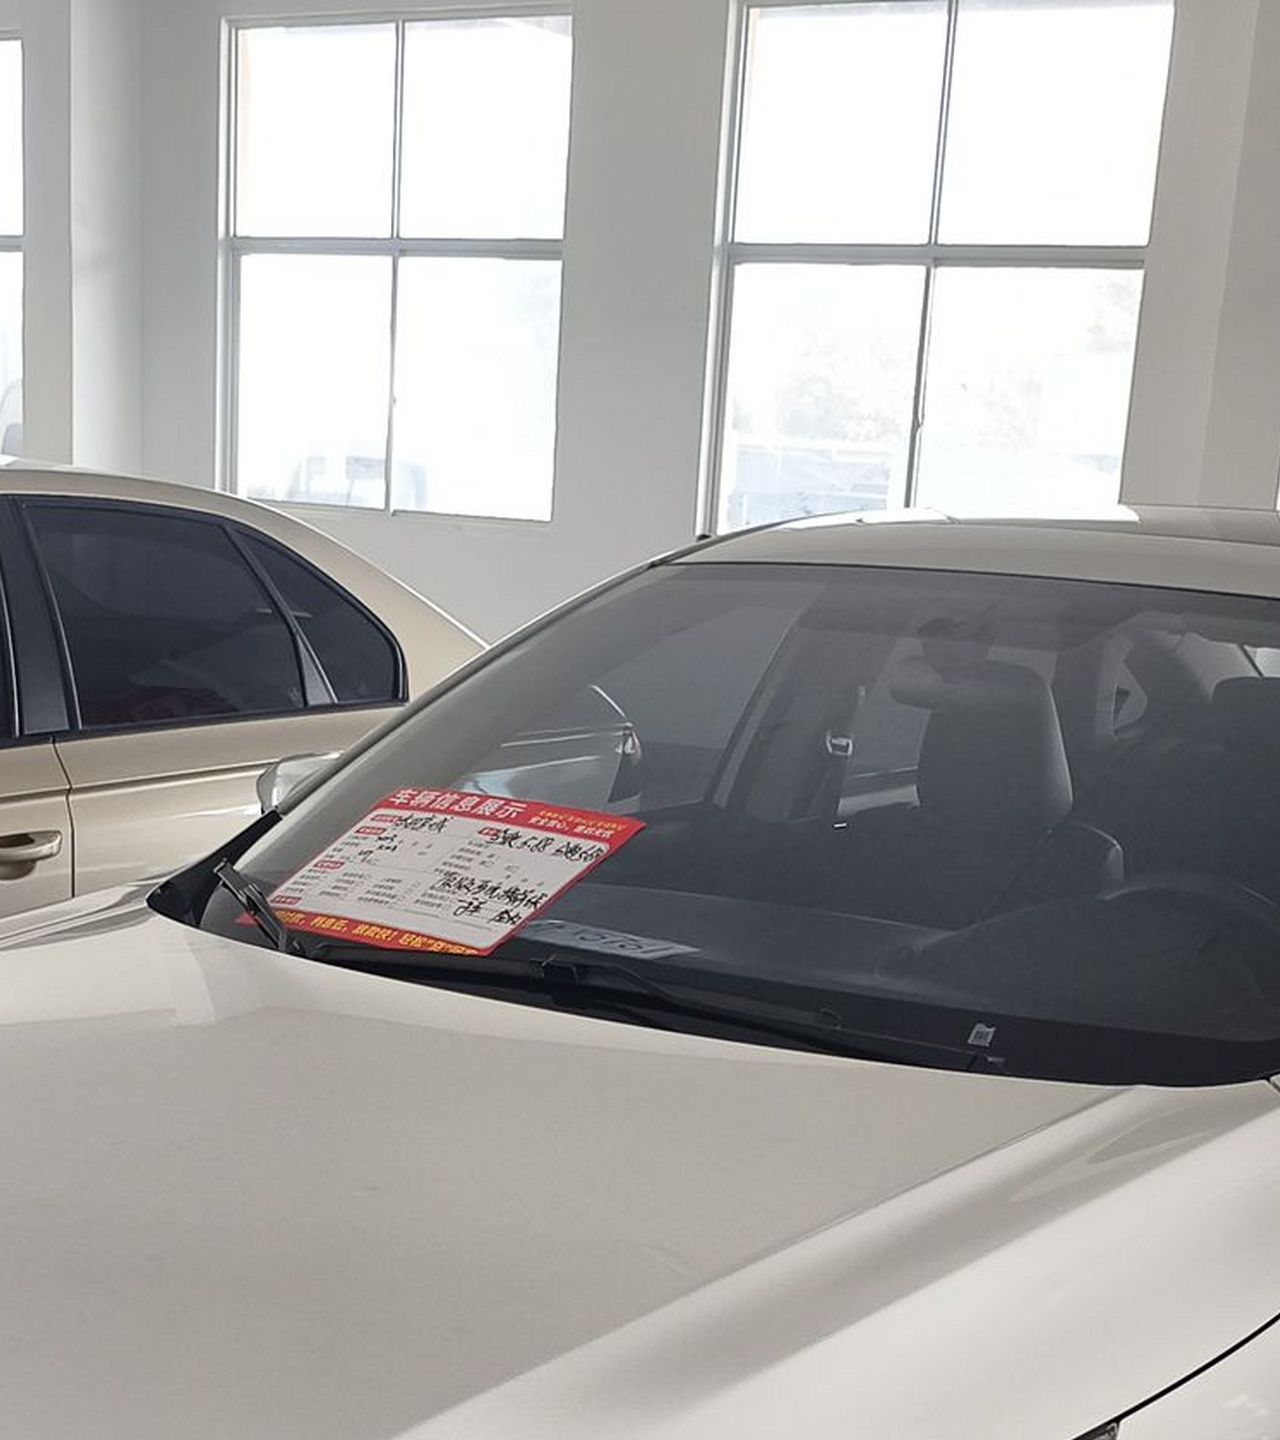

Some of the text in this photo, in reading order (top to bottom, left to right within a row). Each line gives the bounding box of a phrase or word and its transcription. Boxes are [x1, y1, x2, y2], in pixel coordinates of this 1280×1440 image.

[390, 789, 528, 818] 车辆信息展示
